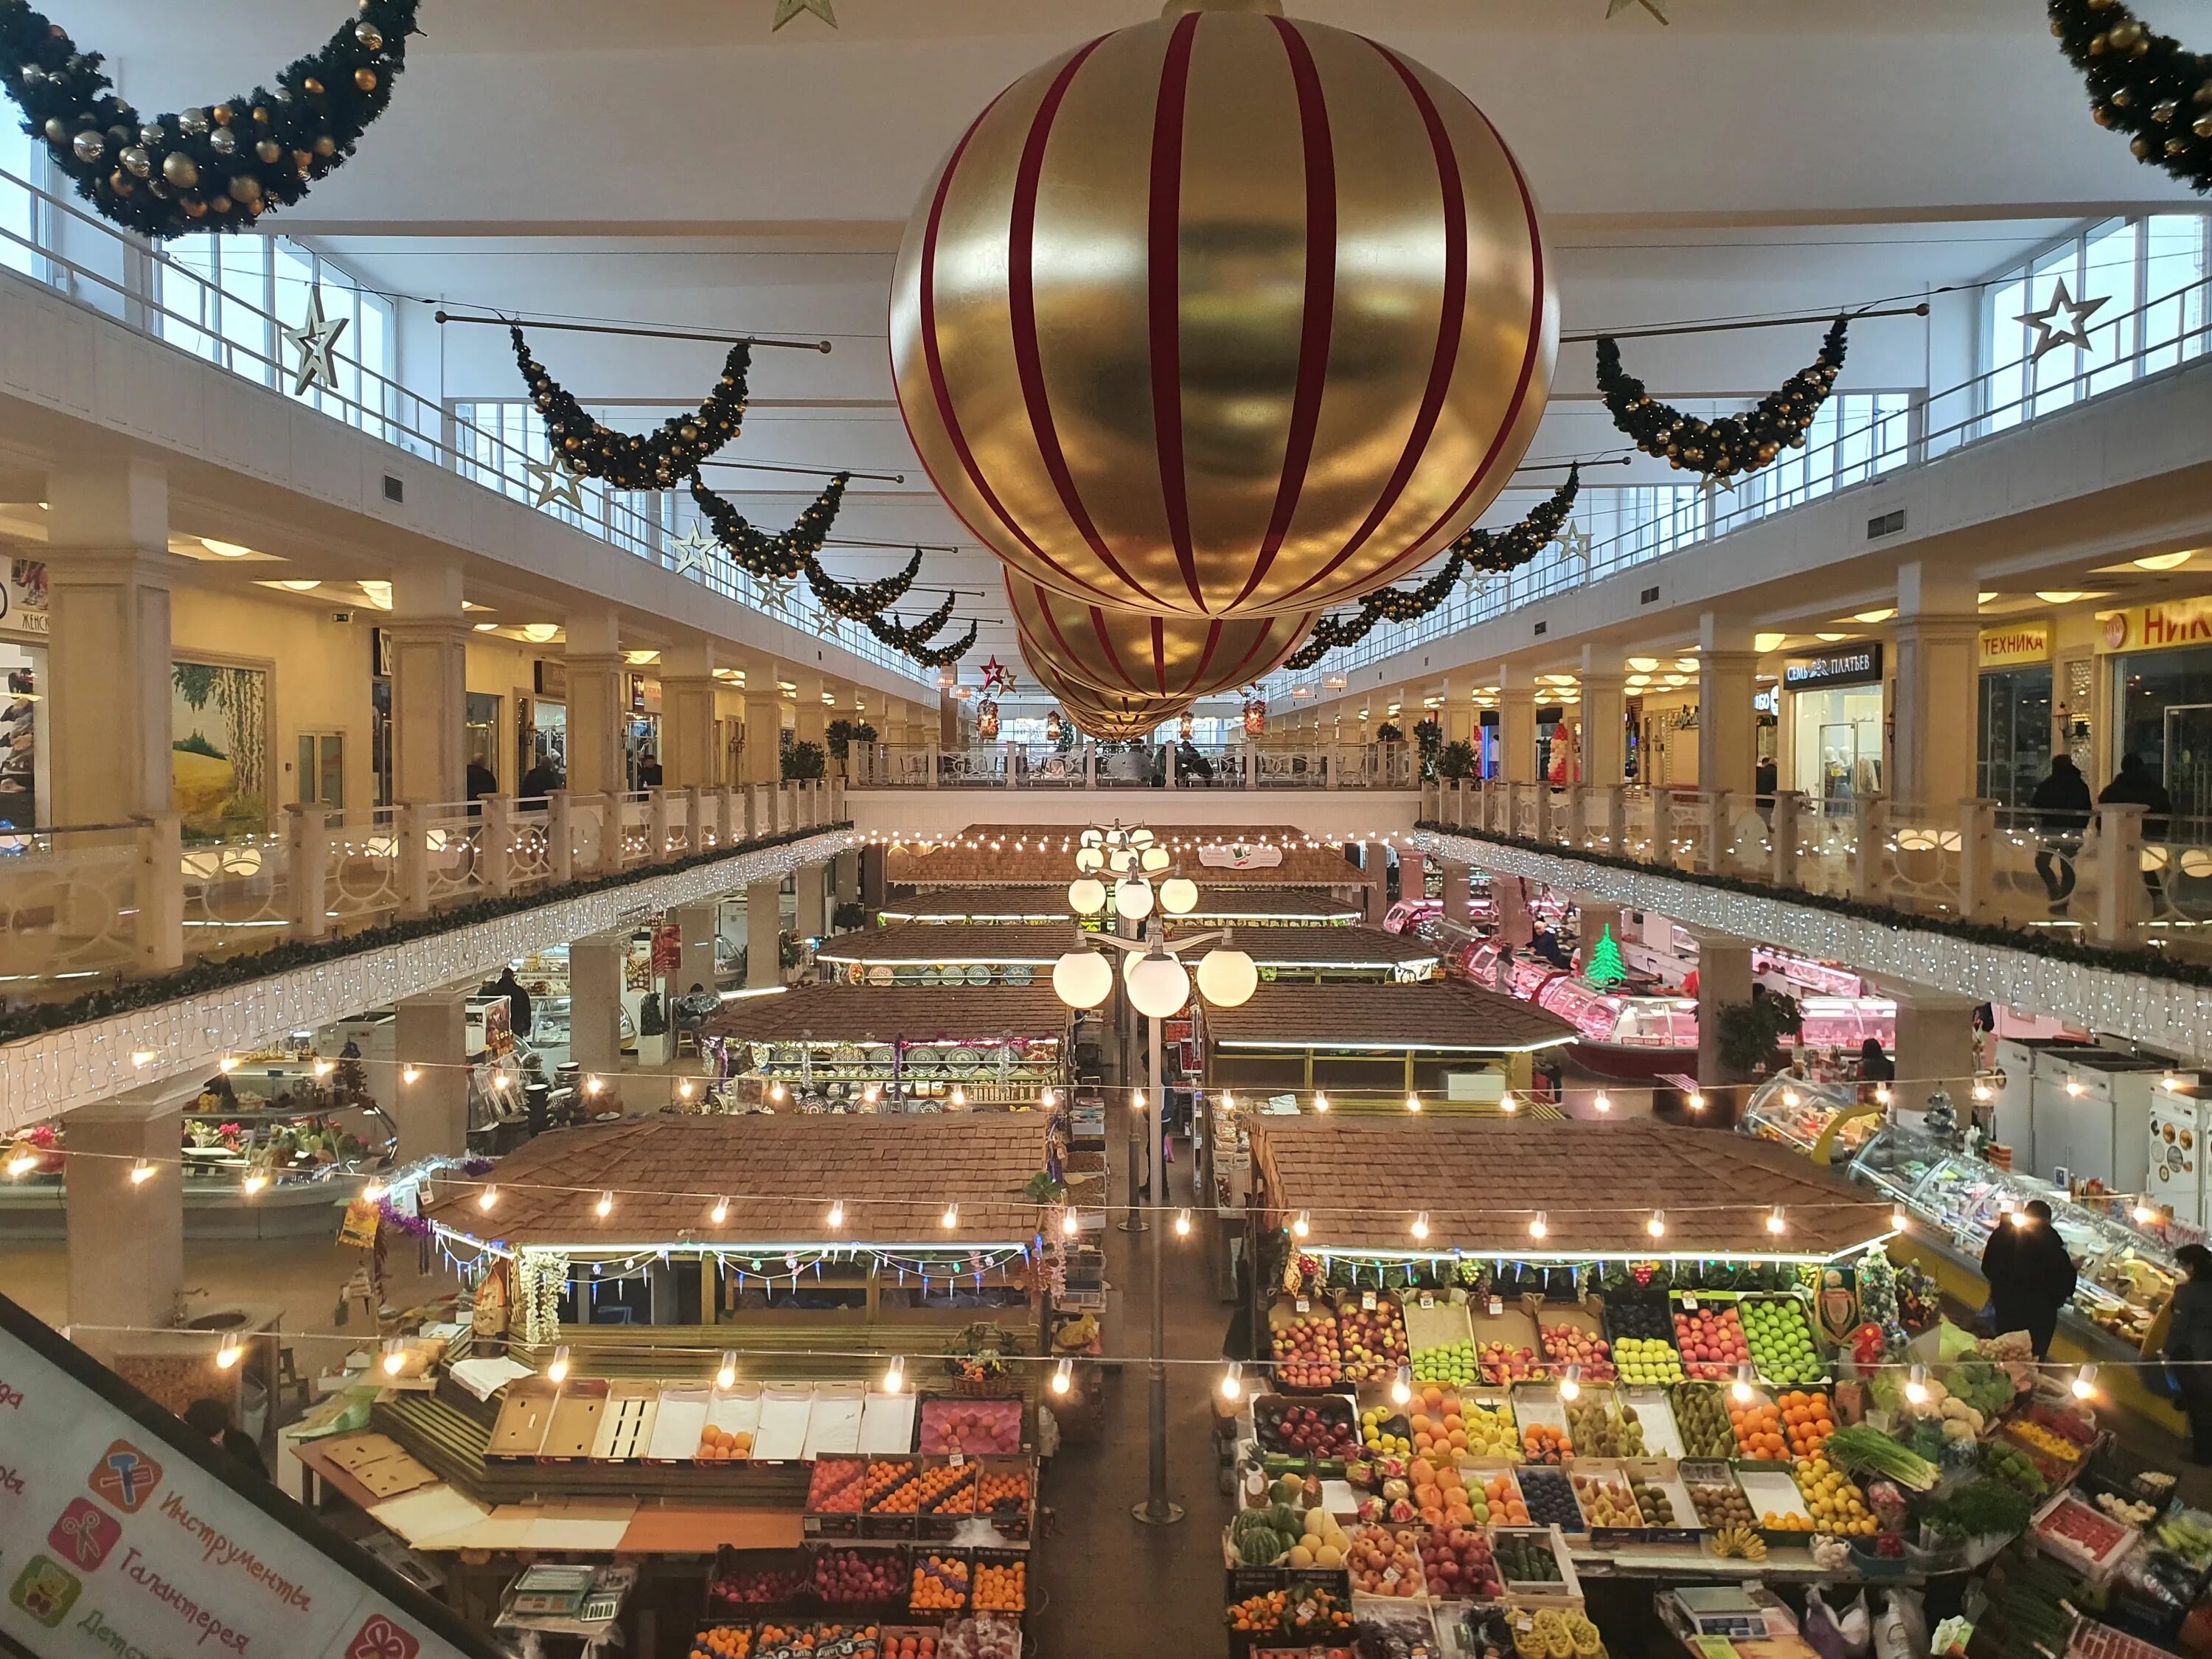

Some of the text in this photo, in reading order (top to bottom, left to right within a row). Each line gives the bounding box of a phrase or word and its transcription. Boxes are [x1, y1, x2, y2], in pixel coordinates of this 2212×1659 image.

[1787, 654, 1870, 681] СЕМЬ ПЛАТЬЕВ
[1983, 634, 2043, 656] ТЕХНИКА
[159, 1490, 311, 1612] Инструменты
[120, 1547, 249, 1655] Галантерея
